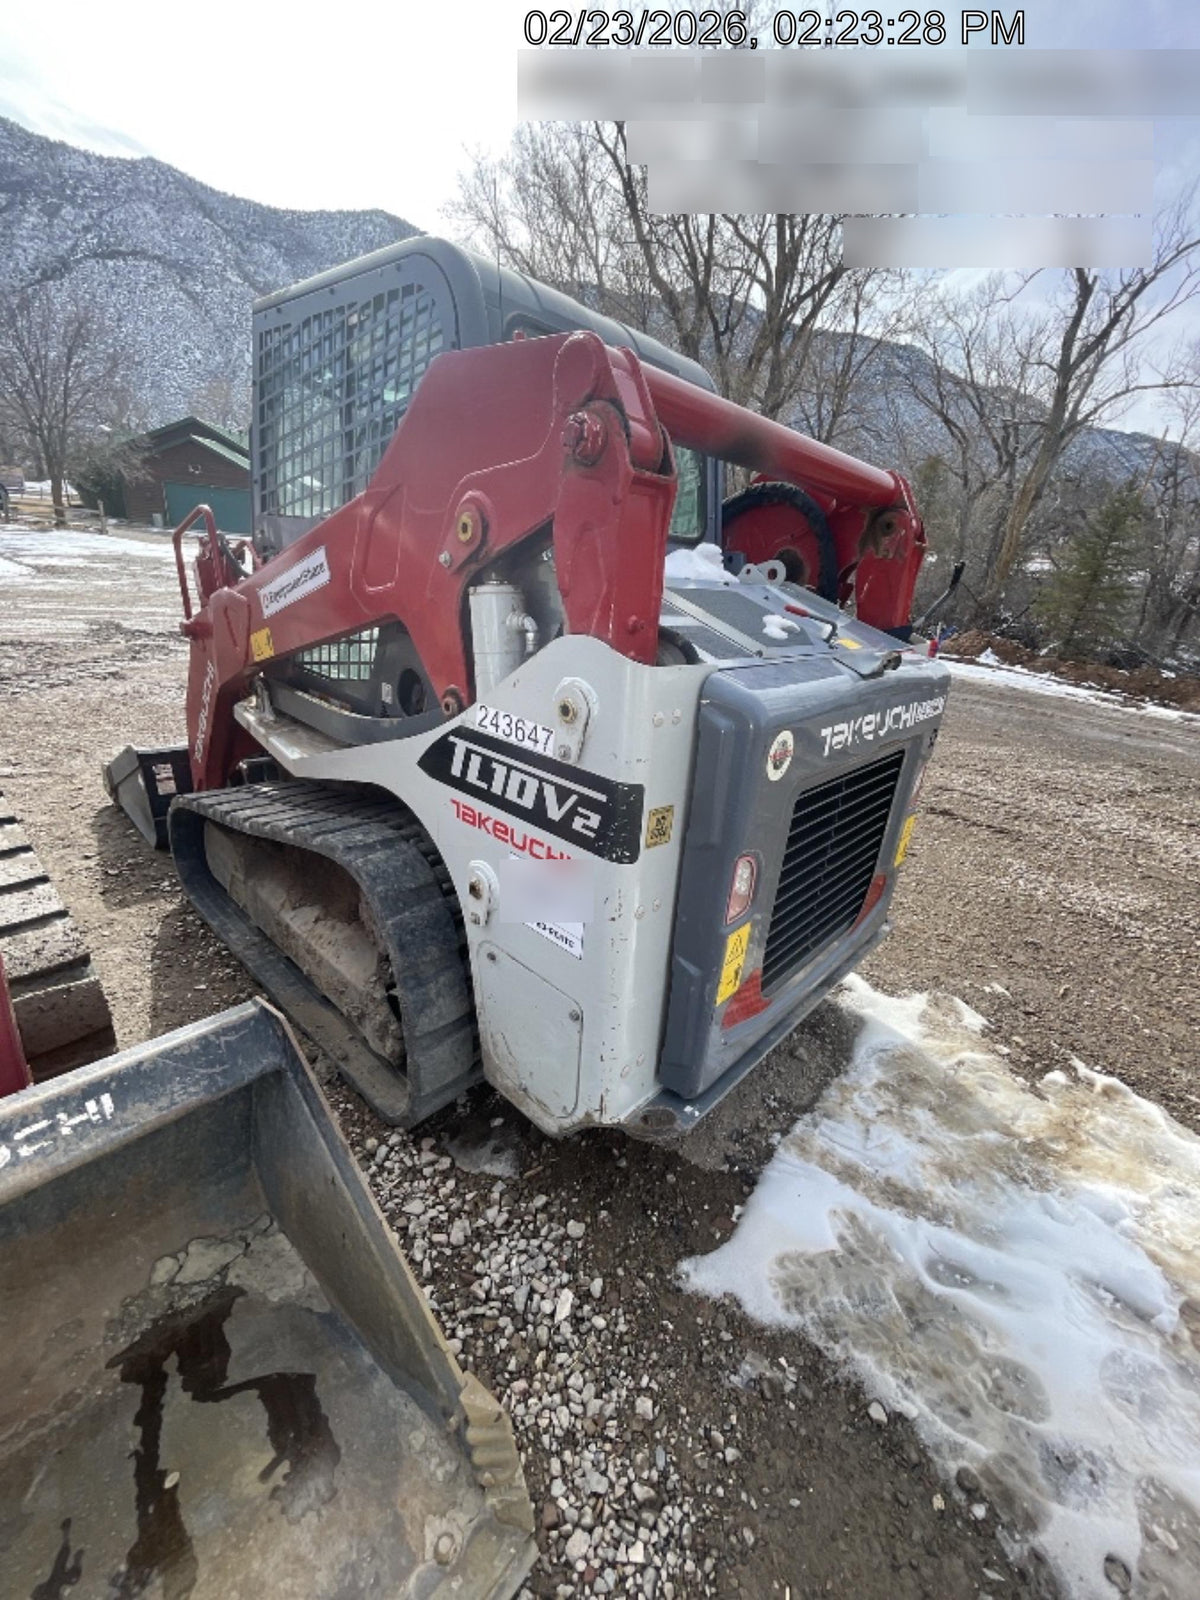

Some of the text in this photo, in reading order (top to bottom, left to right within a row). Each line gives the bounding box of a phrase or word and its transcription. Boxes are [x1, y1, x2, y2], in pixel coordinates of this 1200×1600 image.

[478, 705, 554, 751] 243647
[447, 735, 607, 838] TL10V2
[450, 798, 572, 860] TAKEUC
